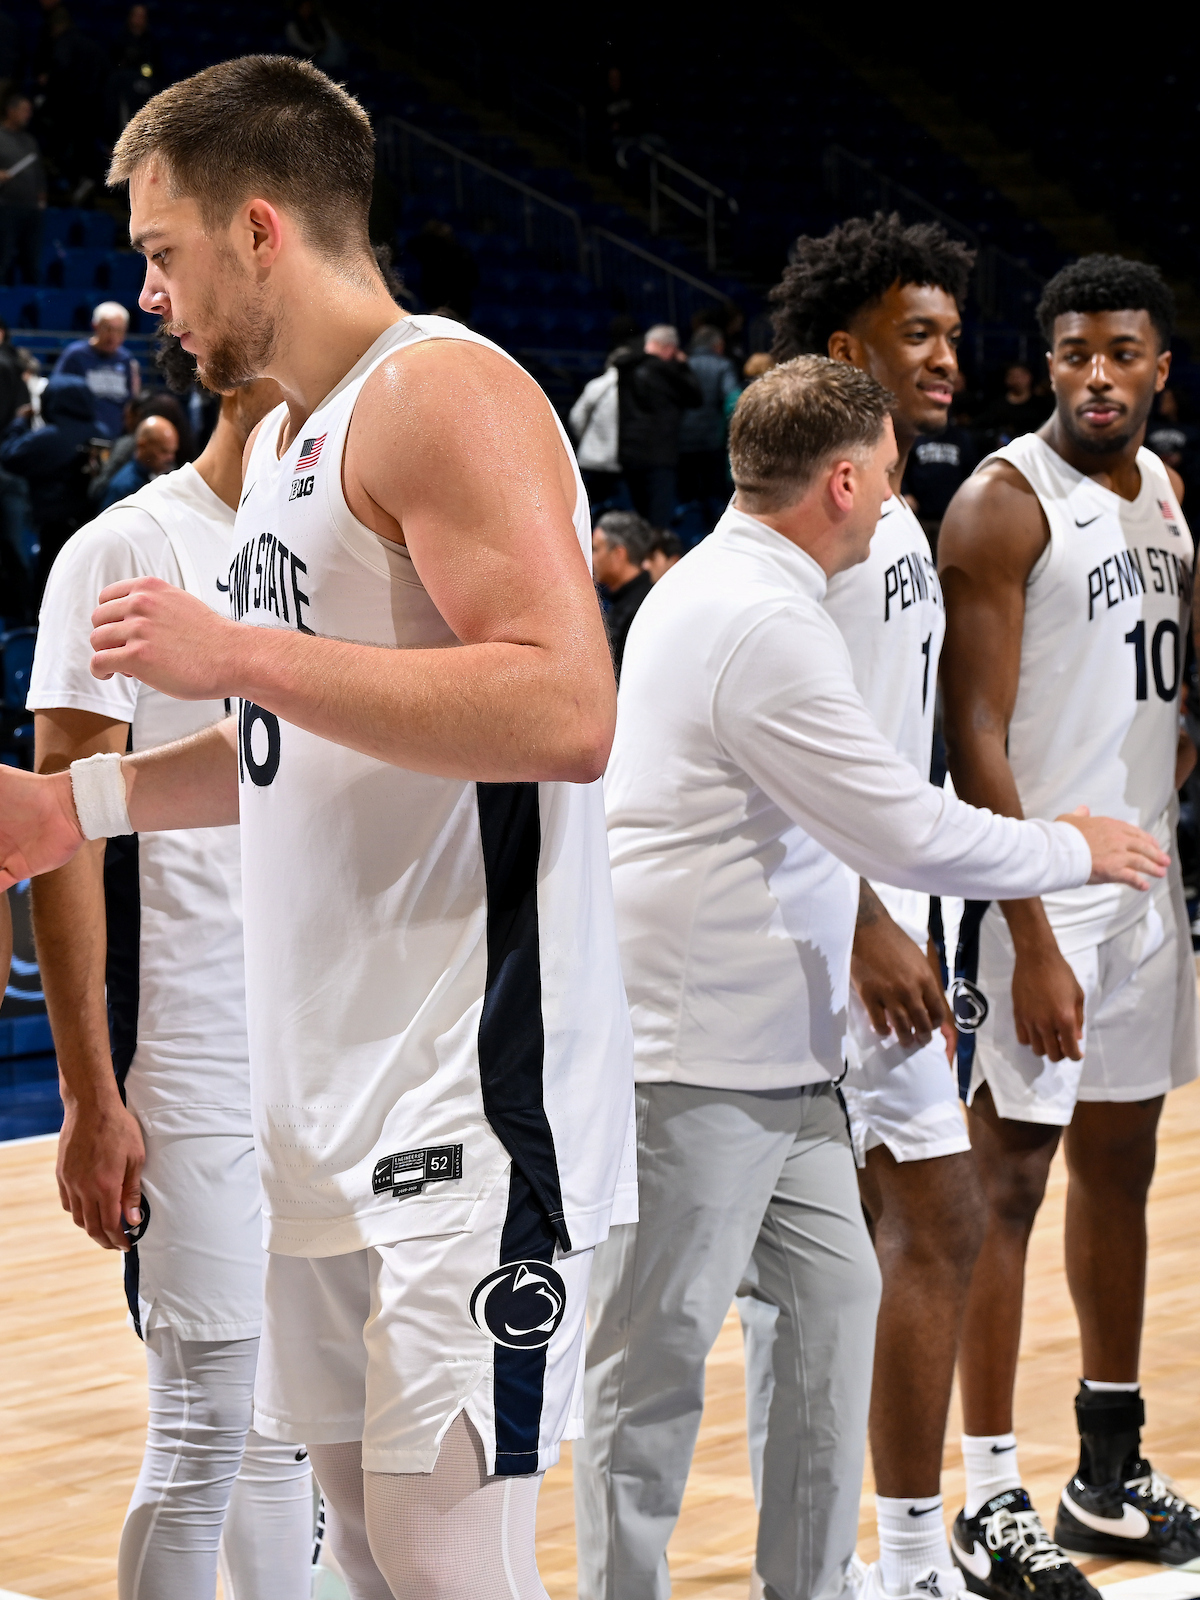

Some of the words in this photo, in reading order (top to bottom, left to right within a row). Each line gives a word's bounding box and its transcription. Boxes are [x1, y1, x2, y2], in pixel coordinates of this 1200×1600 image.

[253, 532, 316, 636] STATE
[884, 552, 929, 622] PENN
[1088, 548, 1147, 622] PENN
[1124, 619, 1180, 702] 10
[374, 1175, 391, 1184] TEAM
[430, 1155, 449, 1171] 52
